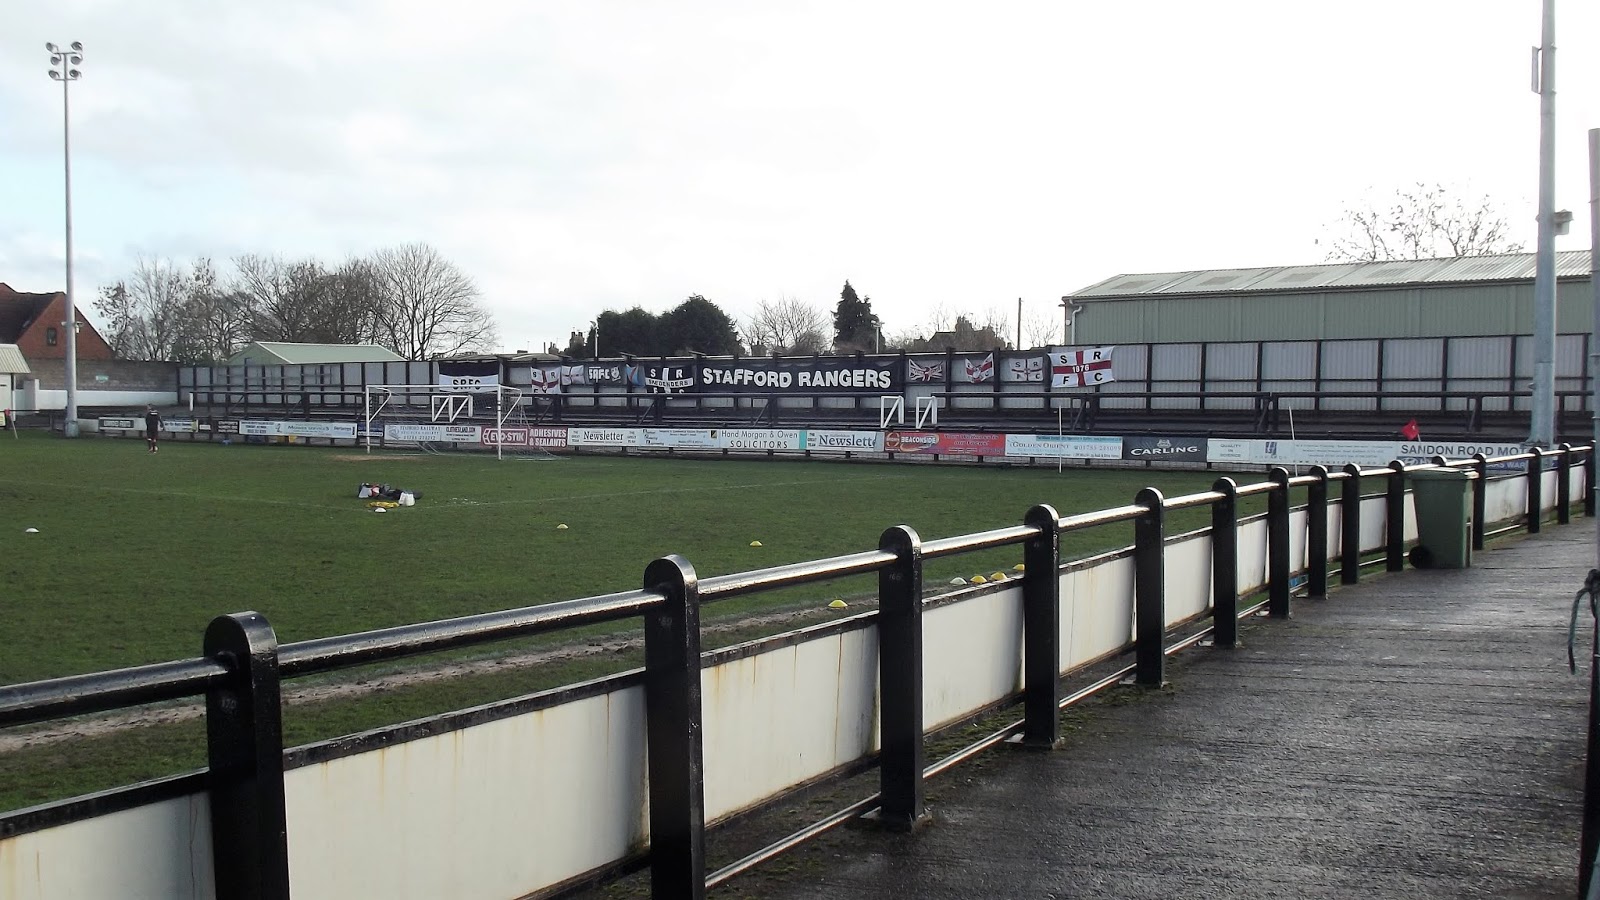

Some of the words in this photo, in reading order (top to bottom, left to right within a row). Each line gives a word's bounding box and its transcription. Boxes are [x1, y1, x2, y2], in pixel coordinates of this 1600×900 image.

[1060, 355, 1068, 364] S
[1093, 351, 1101, 360] R
[650, 368, 656, 378] S
[676, 369, 683, 378] R
[702, 367, 793, 388] STAFFORD
[798, 369, 891, 389] RANGERS
[1063, 376, 1070, 385] F
[1094, 372, 1102, 382] C
[529, 429, 567, 438] ADHESIVES
[583, 430, 623, 441] Newsletter
[721, 430, 739, 438] Hand
[741, 430, 767, 439] Morgan
[769, 430, 774, 438] &
[777, 430, 798, 438] Owen
[529, 438, 534, 446] &
[535, 438, 567, 447] SEALANTS
[730, 440, 788, 449] SOLICITORS
[900, 436, 936, 444] BEACONSIDE
[1130, 446, 1198, 456] CARLING
[1401, 445, 1454, 455] SANDON
[1457, 446, 1494, 456] ROAD
